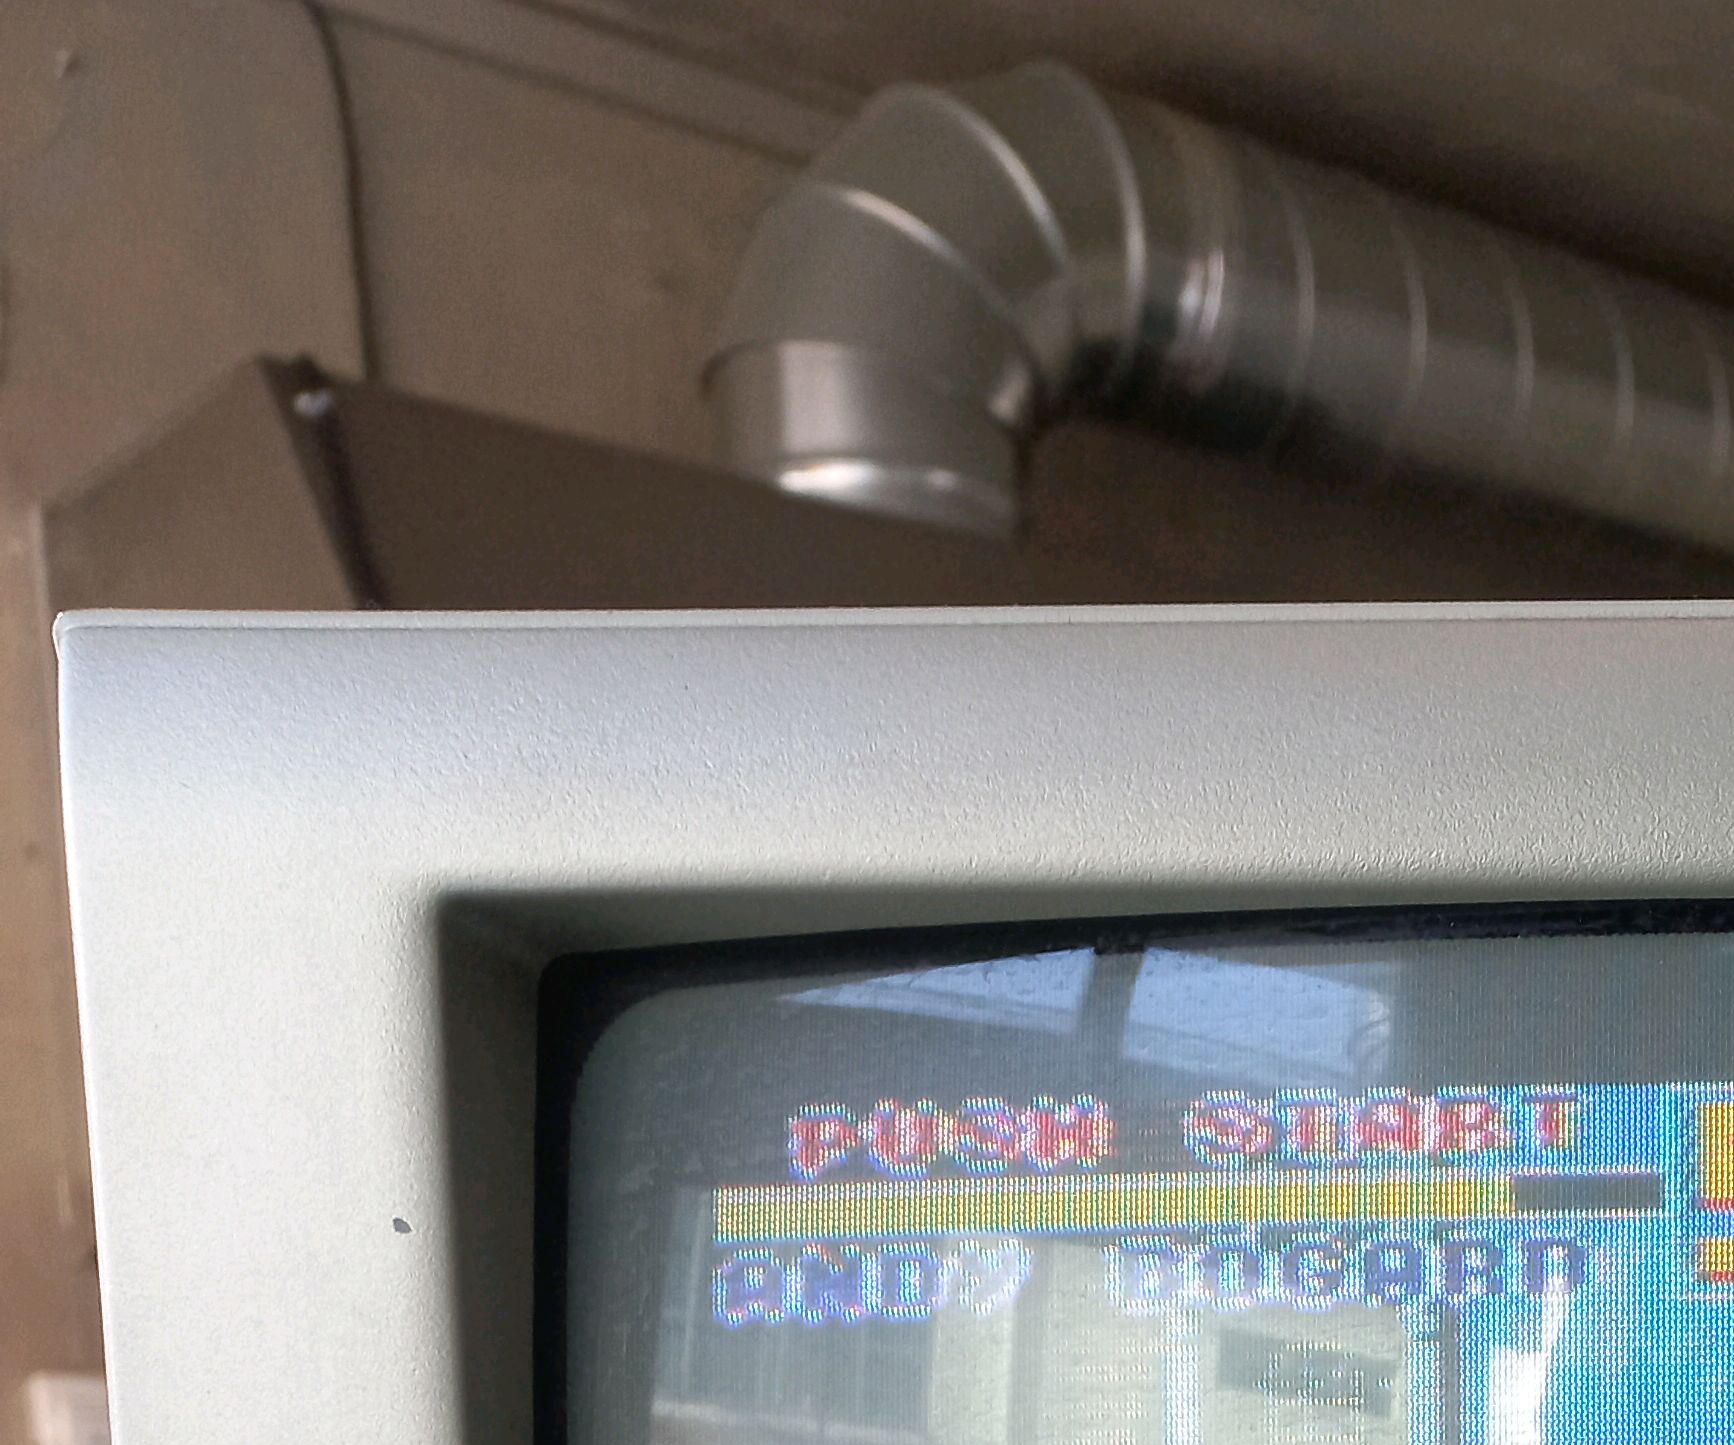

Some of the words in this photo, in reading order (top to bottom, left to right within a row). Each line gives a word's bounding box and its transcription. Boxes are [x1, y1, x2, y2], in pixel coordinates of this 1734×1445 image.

[787, 1096, 1120, 1178] PUSH
[1180, 1088, 1582, 1165] START
[714, 1239, 1032, 1324] ANDY
